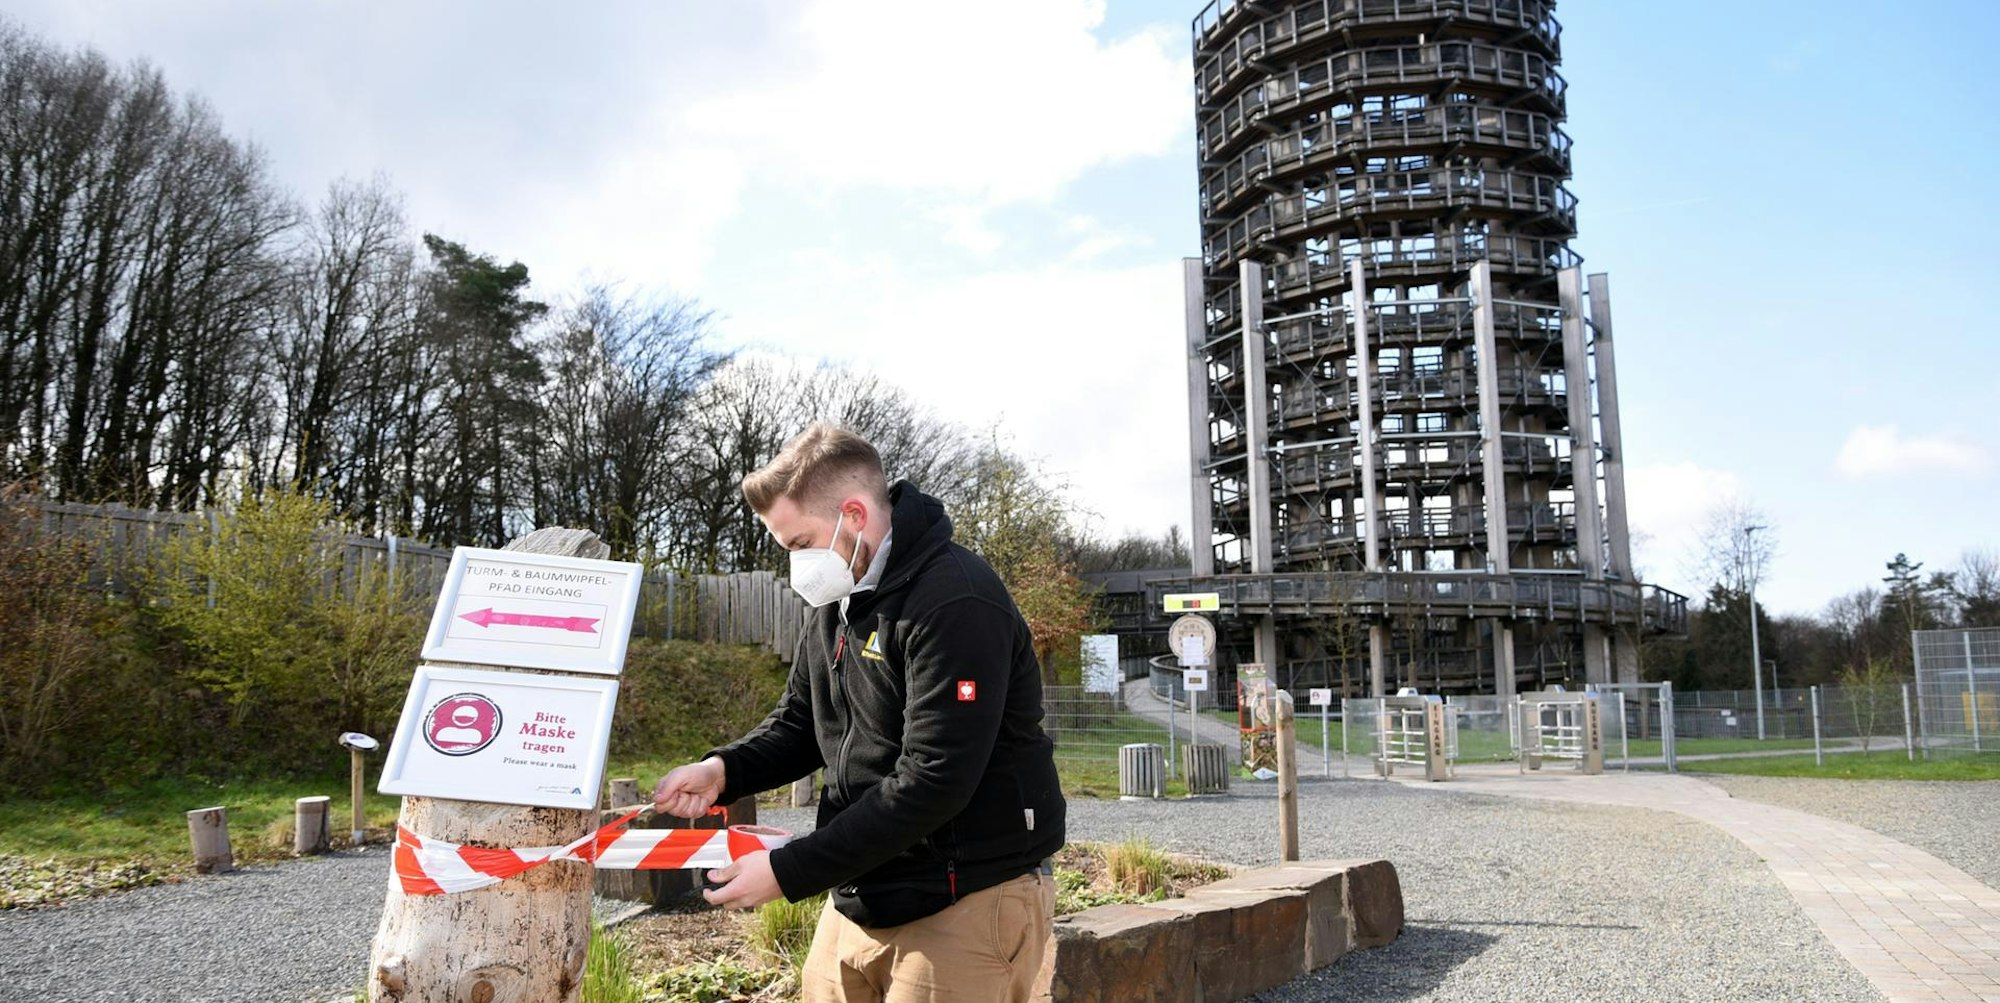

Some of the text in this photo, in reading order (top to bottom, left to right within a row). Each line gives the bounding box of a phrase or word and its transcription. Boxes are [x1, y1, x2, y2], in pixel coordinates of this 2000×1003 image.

[466, 566, 613, 585] TURM- & BAUMWIPFEL-
[489, 582, 583, 599] PFAD EINGANG
[535, 711, 567, 724] Bitte
[518, 722, 576, 739] Maske
[1433, 704, 1441, 756] EINGANG
[522, 741, 566, 754] tragen
[503, 756, 528, 765] Please
[556, 762, 577, 770] mask
